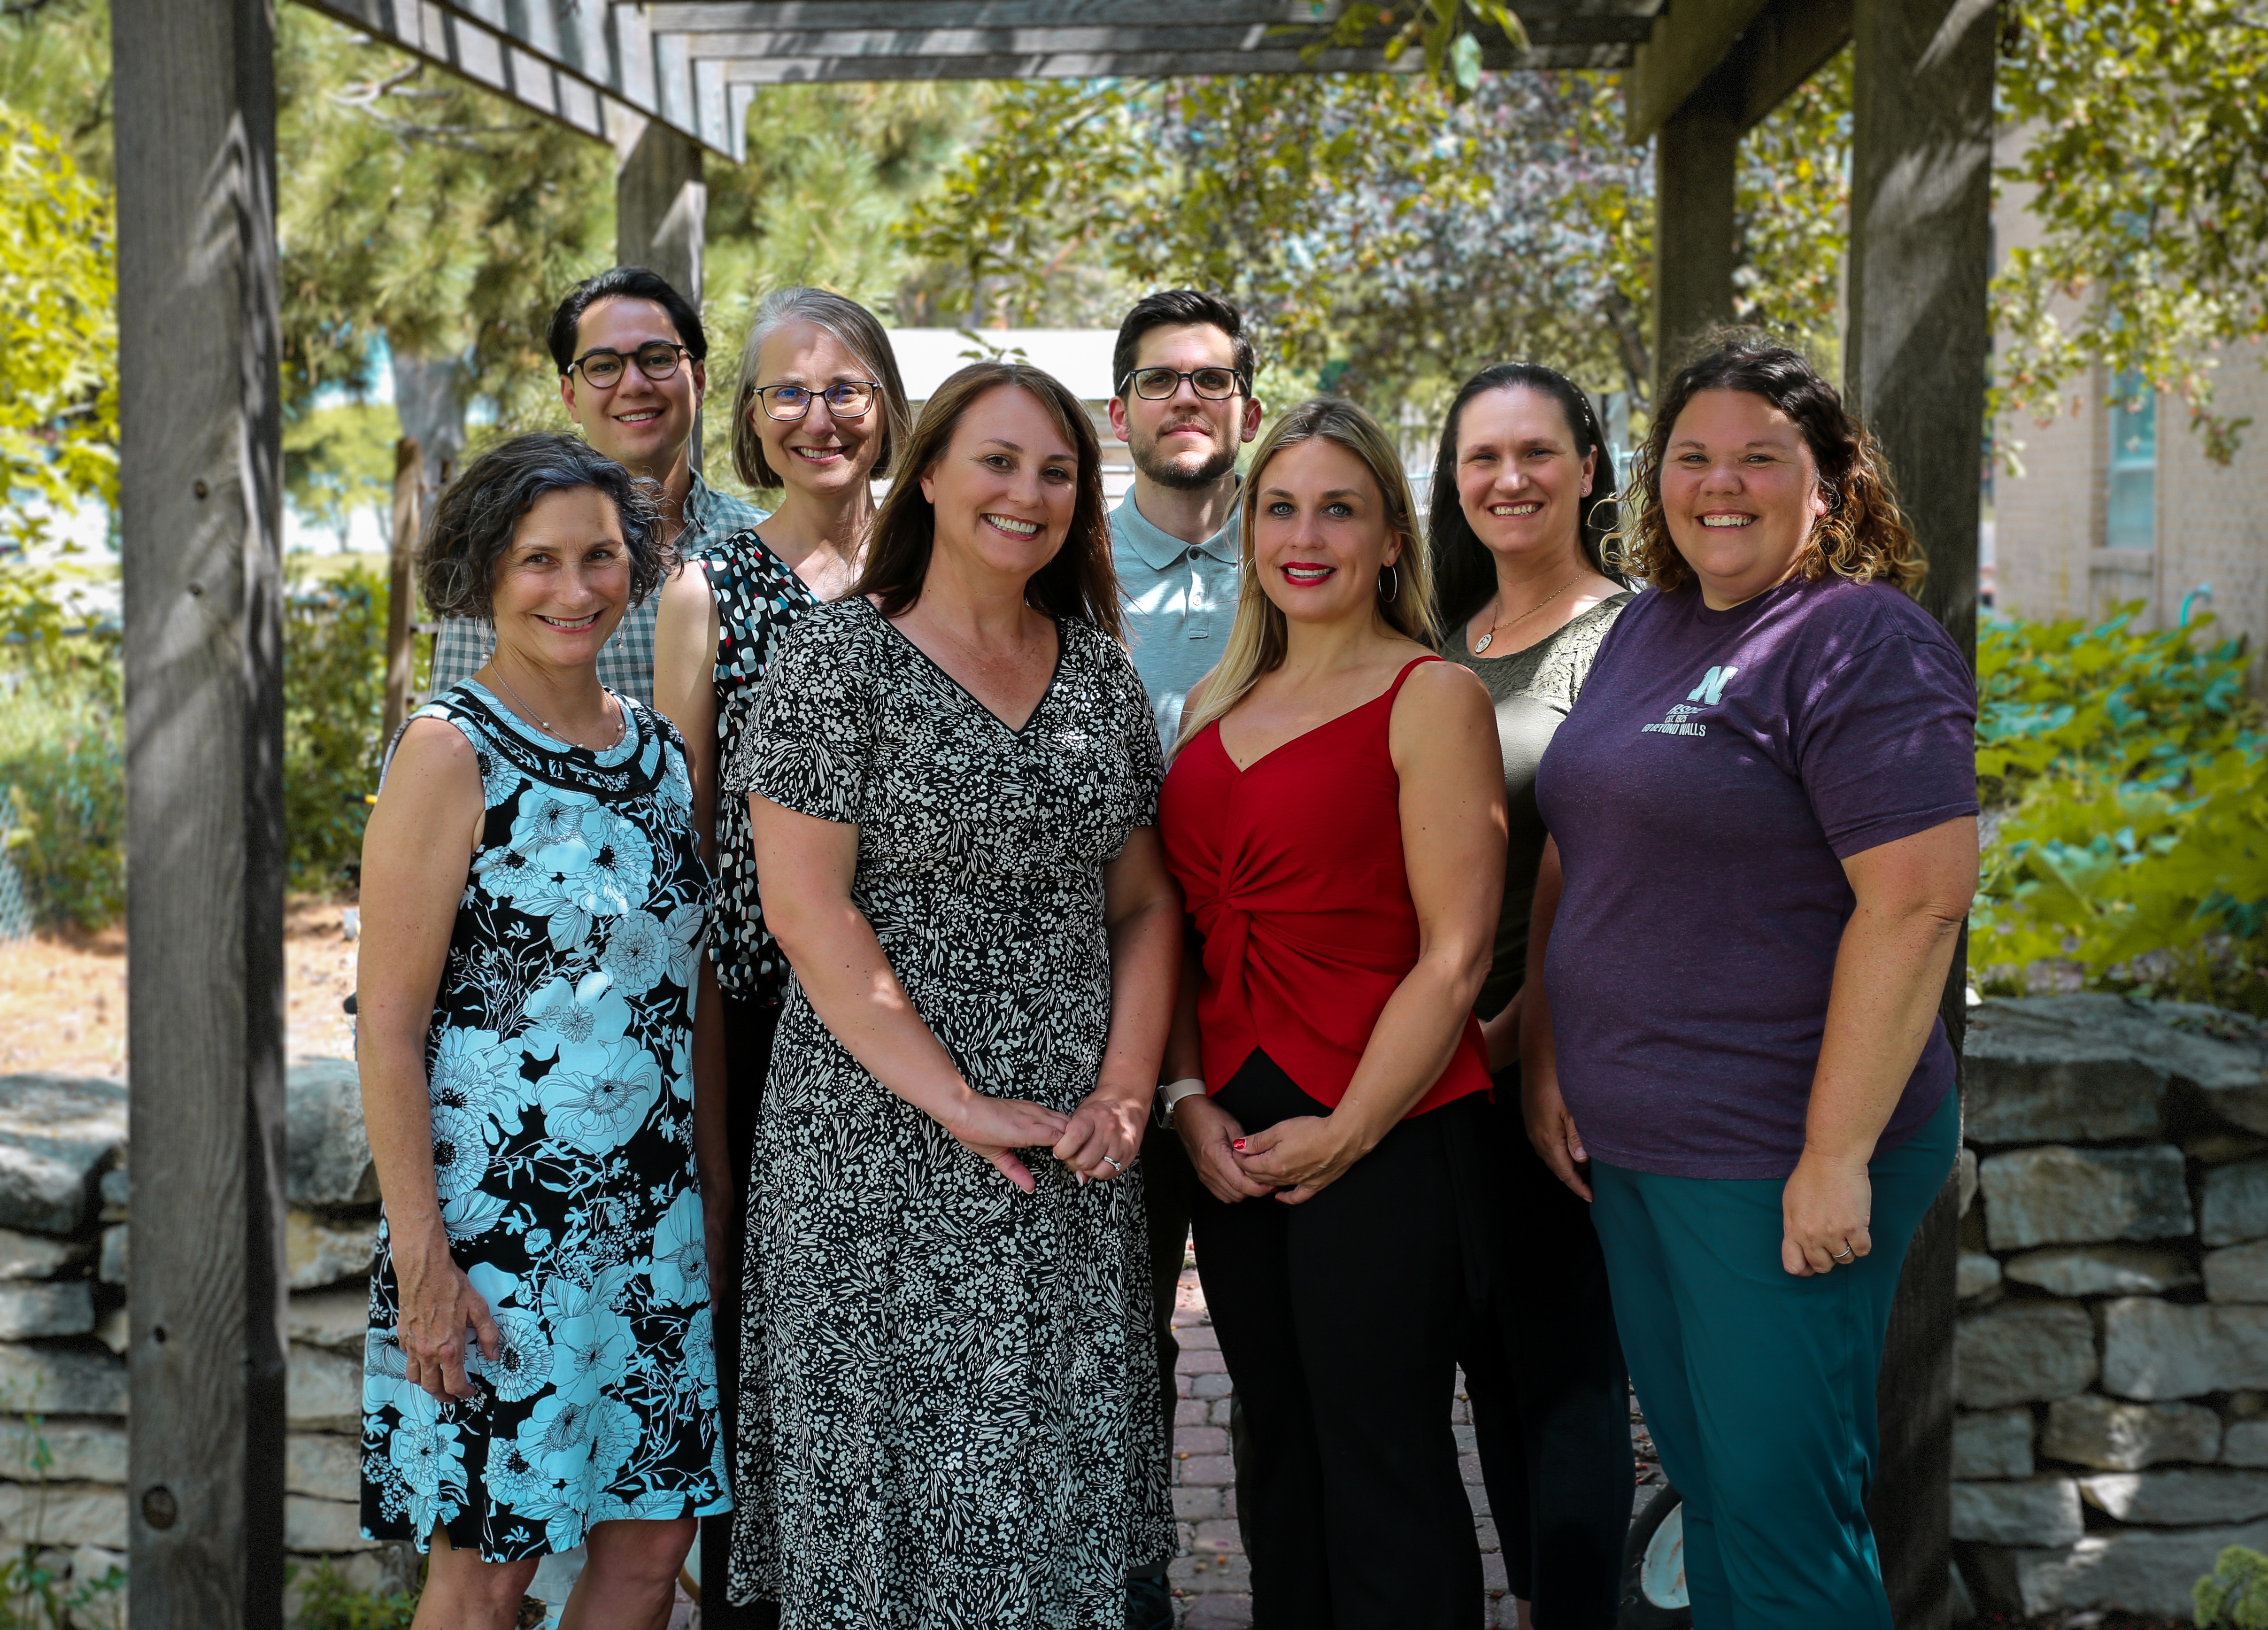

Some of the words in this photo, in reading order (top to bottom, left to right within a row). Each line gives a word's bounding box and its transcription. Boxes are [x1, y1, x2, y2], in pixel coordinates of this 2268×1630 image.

[1687, 666, 1738, 705] N
[1641, 724, 1654, 732] GO
[1649, 723, 1680, 734] BEYOND
[1679, 723, 1706, 737] WALLS
